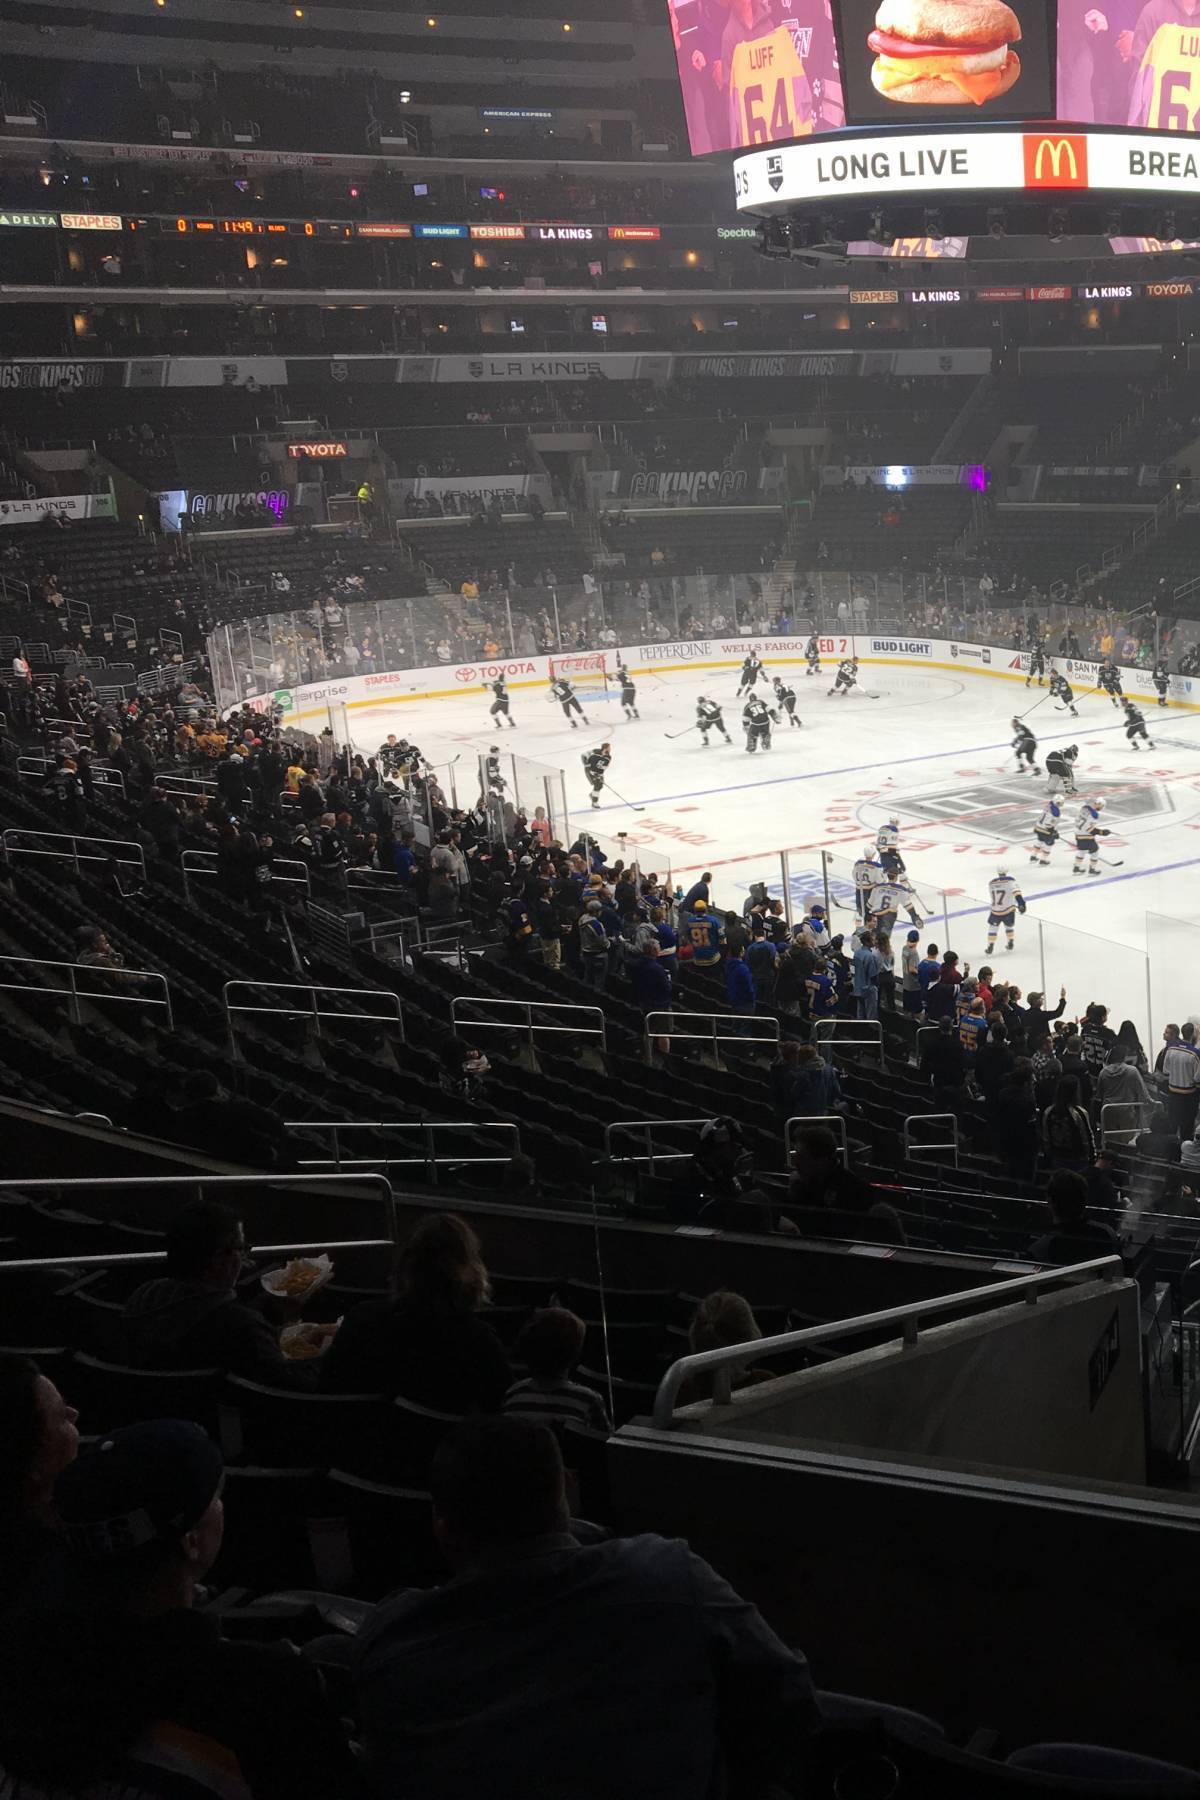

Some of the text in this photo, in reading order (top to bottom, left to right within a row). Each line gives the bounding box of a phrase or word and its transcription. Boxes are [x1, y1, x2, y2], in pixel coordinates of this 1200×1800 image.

[749, 46, 775, 71] LUFF
[483, 110, 520, 118] AMERICAN
[743, 77, 794, 146] 64
[817, 149, 968, 183] LONG LIVE
[13, 214, 57, 227] DELTA
[63, 214, 121, 229] STAPLES
[176, 218, 187, 232] 0
[224, 216, 254, 233] 11:49
[304, 223, 314, 236] 0
[423, 227, 460, 236] BUD LIGHT
[473, 226, 524, 239] TOSHIBA
[540, 228, 593, 240] LA KINGS
[1085, 286, 1132, 299] LA KINGS
[1147, 284, 1193, 295] TOYOTA
[851, 291, 897, 303] STAPLES
[912, 291, 960, 302] LA KINGS
[490, 361, 603, 376] LA KINGS
[289, 444, 347, 457] TOYOTA
[13, 500, 77, 512] LA KINGS
[640, 641, 713, 662] PEPPERDINE
[721, 641, 804, 654] WELLS FARGO
[838, 638, 848, 652] 7
[873, 640, 931, 655] BUD LIGHT
[479, 662, 537, 679] TOYOTA
[1074, 661, 1089, 673] SAN
[364, 673, 401, 686] STAPLES
[1074, 673, 1095, 682] CASINO
[880, 895, 890, 909] 6
[991, 889, 1006, 907] 17
[690, 927, 710, 946] 91
